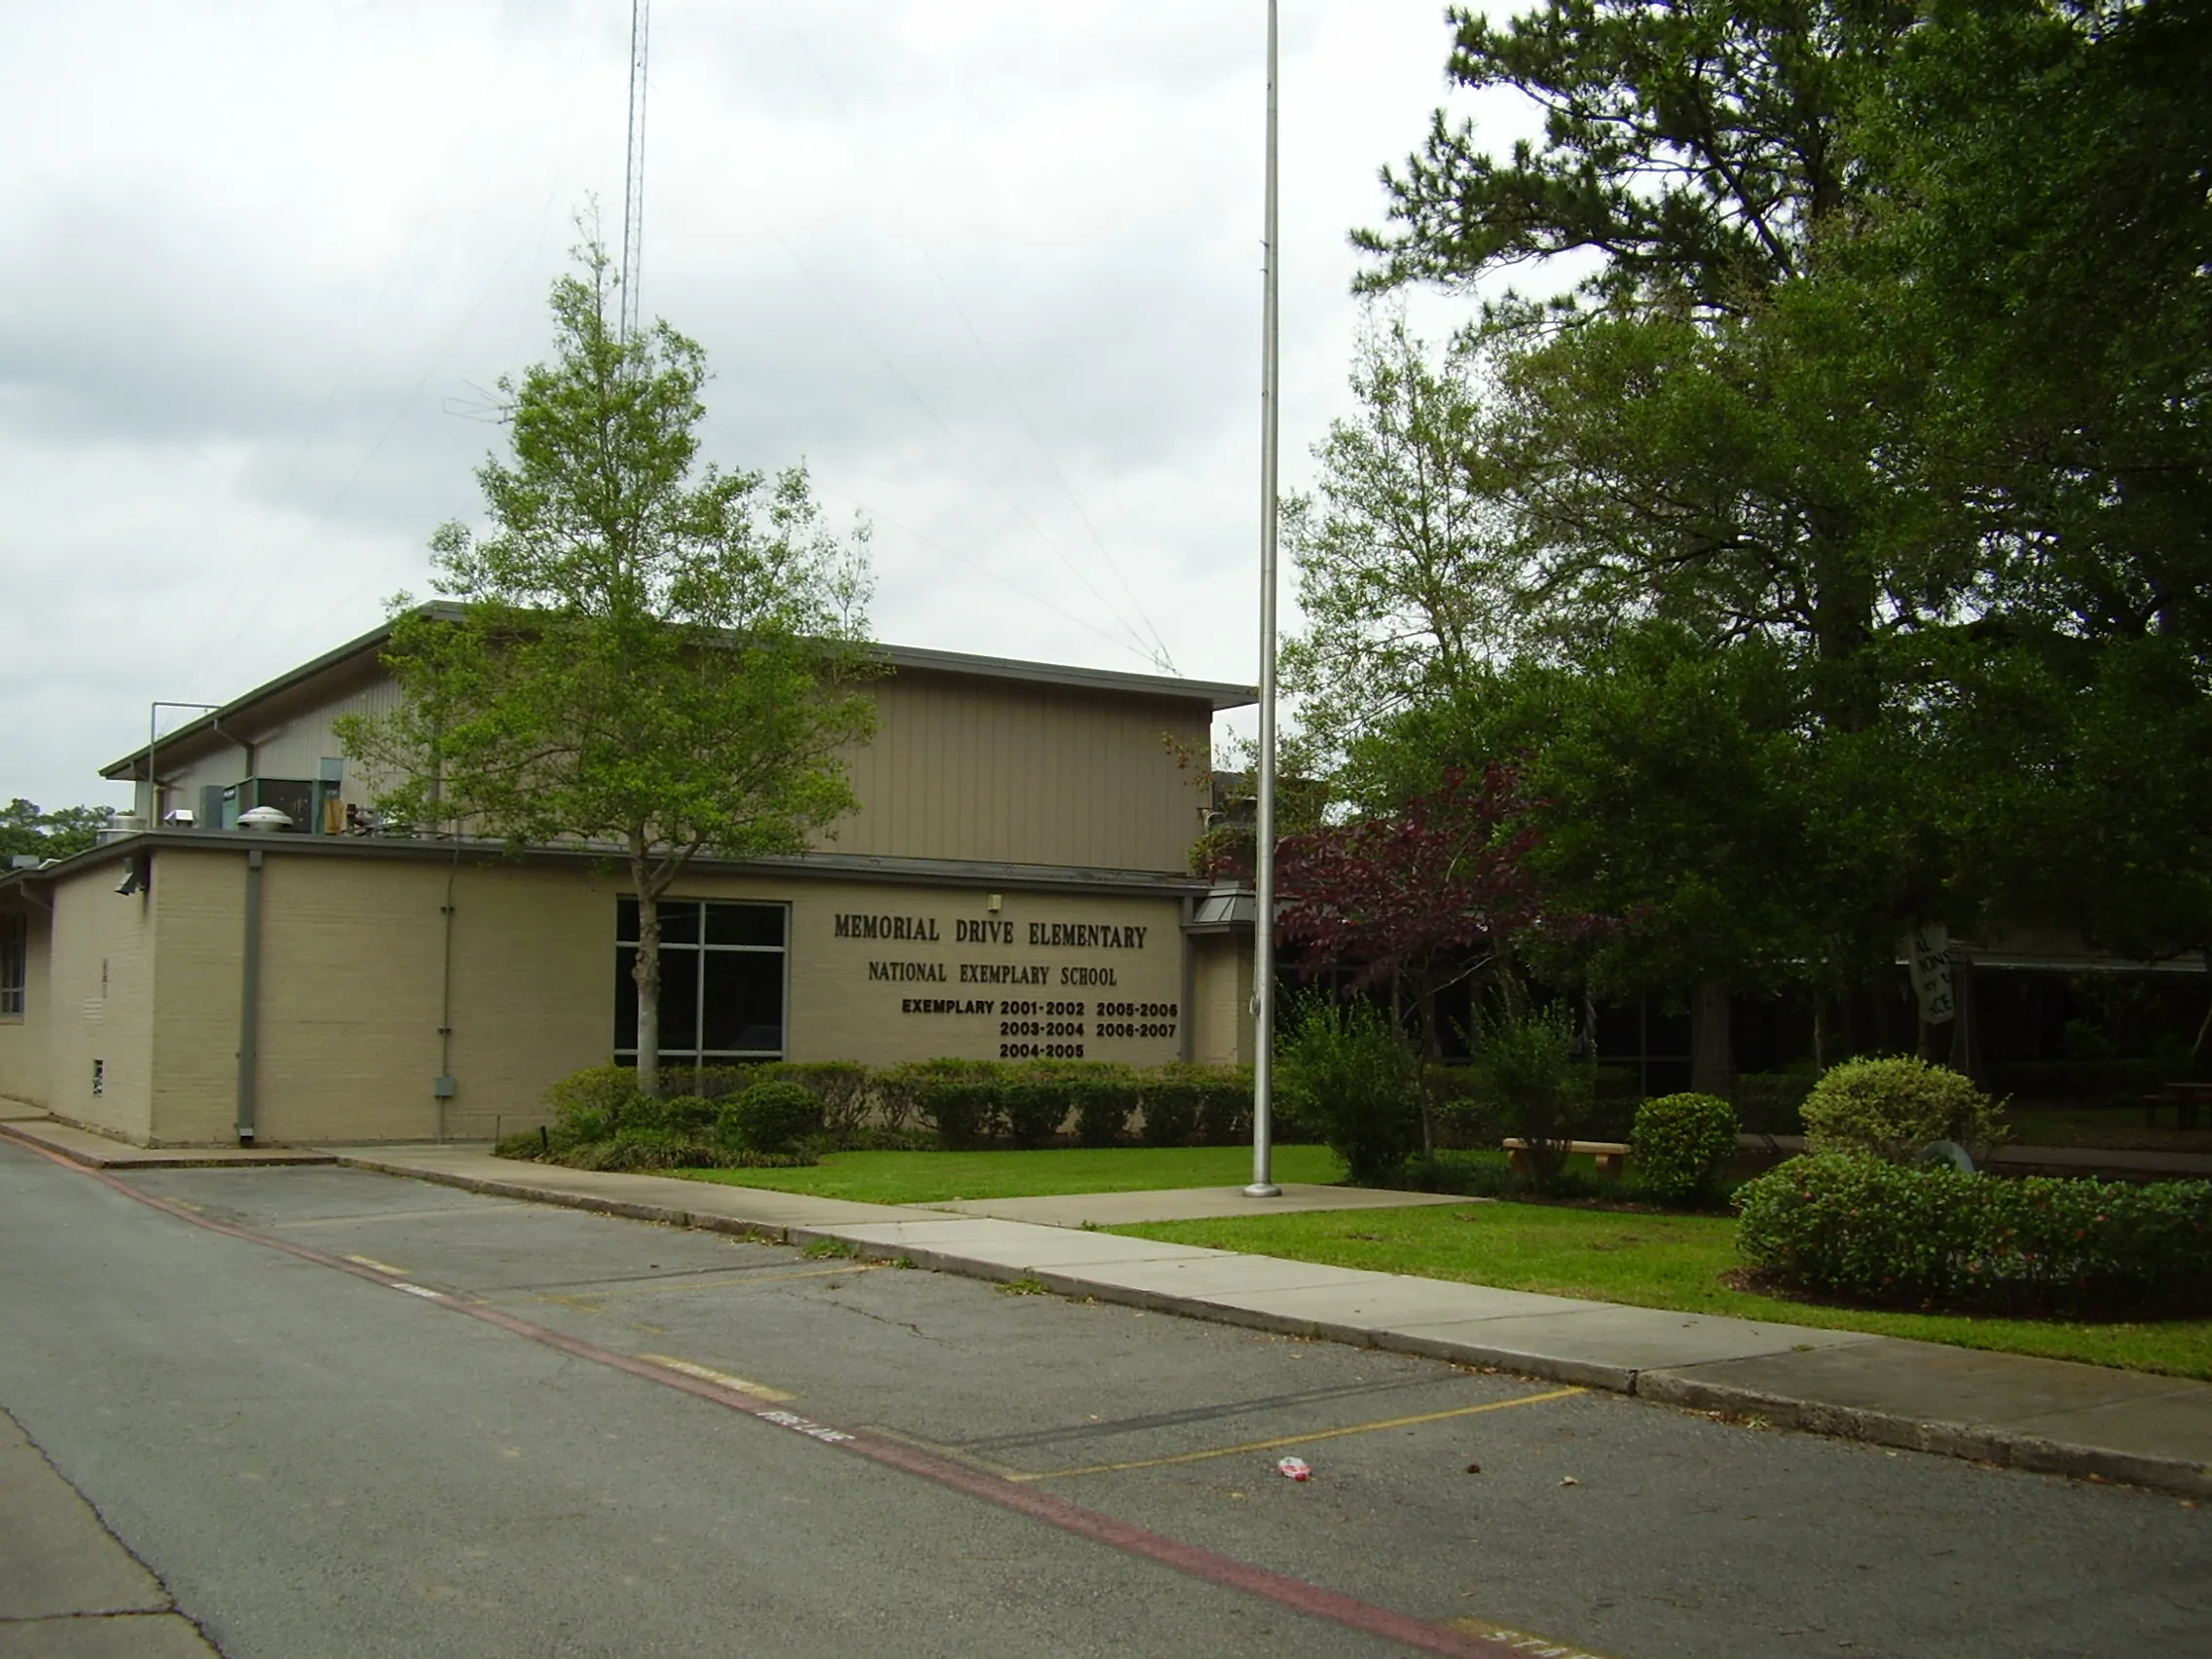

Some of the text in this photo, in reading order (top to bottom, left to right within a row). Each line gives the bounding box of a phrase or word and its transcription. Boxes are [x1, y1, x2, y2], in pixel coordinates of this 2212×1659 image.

[833, 913, 1148, 951] MEMORIAL DRIVE ELEMENTARY
[867, 961, 1119, 987] NATIONAL EXEMPLARY SCHOOL
[902, 998, 1178, 1019] EXEMPLARY 2001-2002 2005-2006
[999, 1021, 1177, 1039] 2003-2004 2006-2007
[999, 1043, 1086, 1059] 2004-2005
